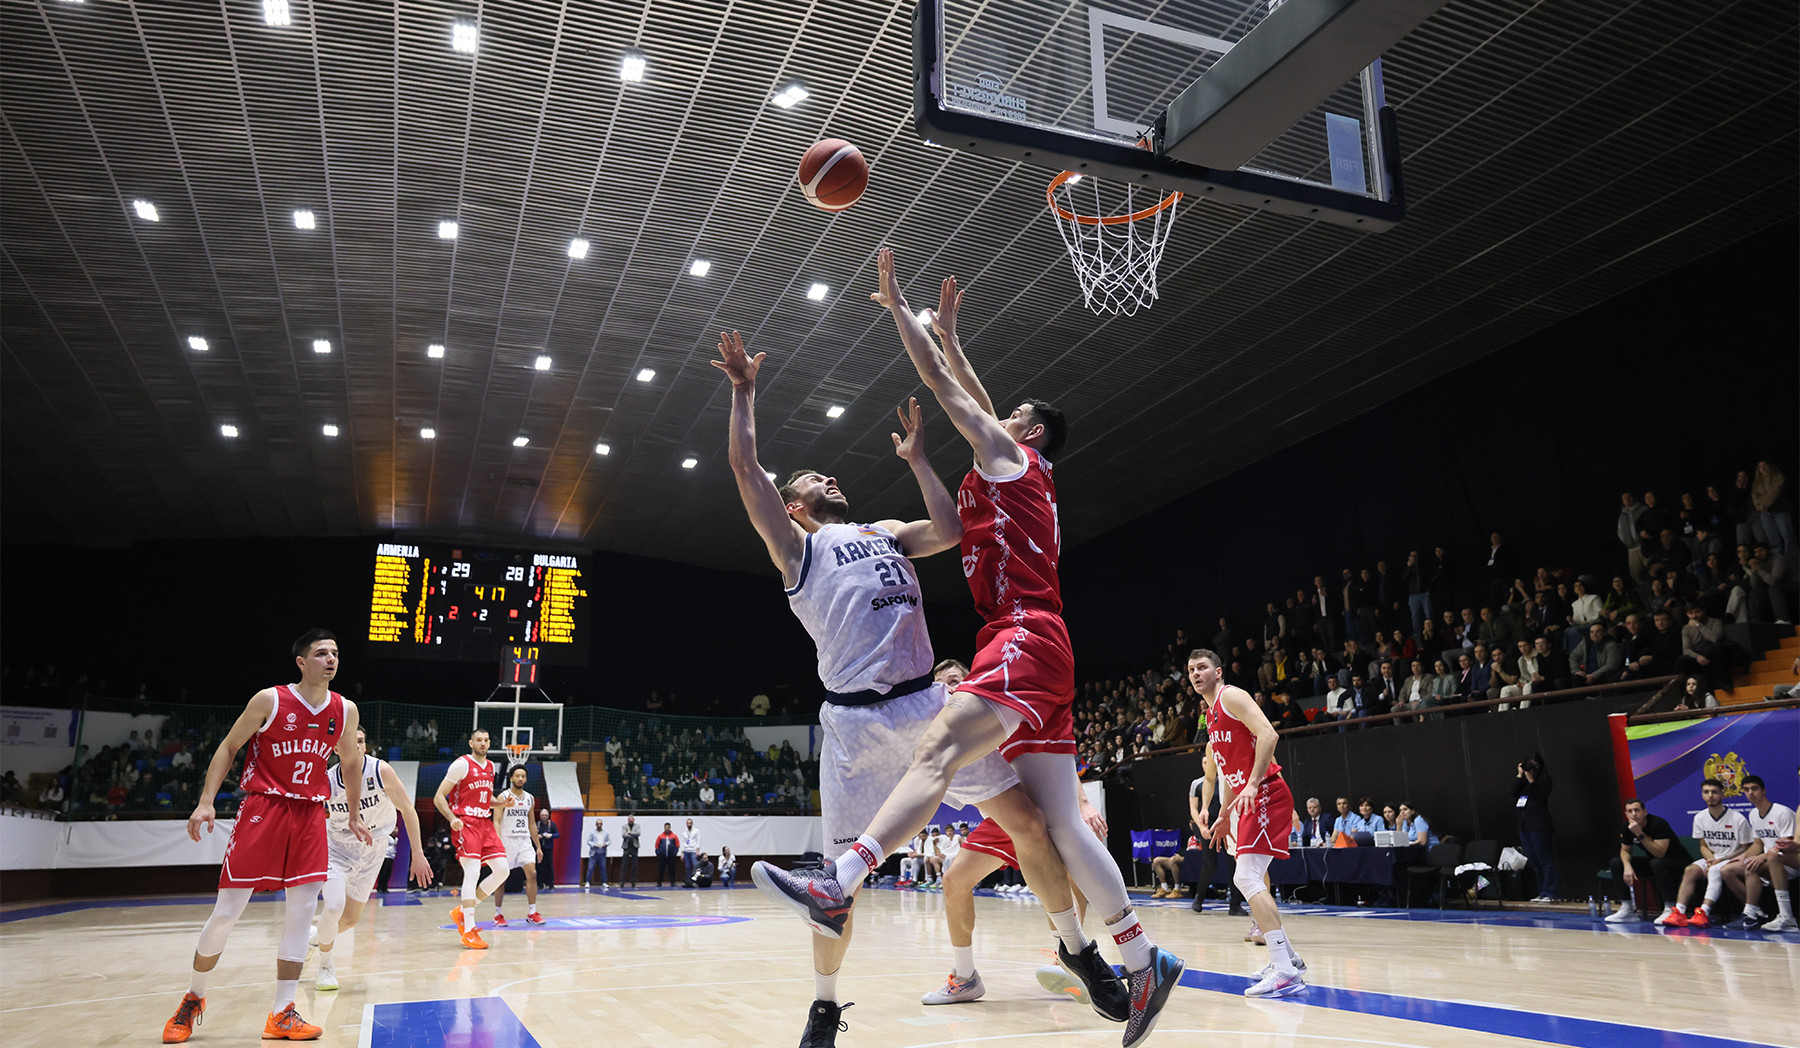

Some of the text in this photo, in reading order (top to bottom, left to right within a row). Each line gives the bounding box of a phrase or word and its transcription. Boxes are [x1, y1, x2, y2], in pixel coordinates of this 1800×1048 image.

[376, 543, 420, 558] ARMENIA
[832, 538, 897, 567] ARMEN
[532, 553, 578, 569] BULGARIA
[451, 562, 471, 578] 29
[505, 565, 525, 582] 28
[874, 560, 908, 587] 21
[871, 593, 918, 611] SAFOIN
[448, 605, 459, 620] 2
[478, 608, 488, 621] 2
[513, 646, 540, 661] 4 17
[291, 760, 314, 785] 22
[330, 794, 380, 813] ARNIA
[833, 835, 861, 845] SAFOIA
[1118, 926, 1143, 943] GSA
